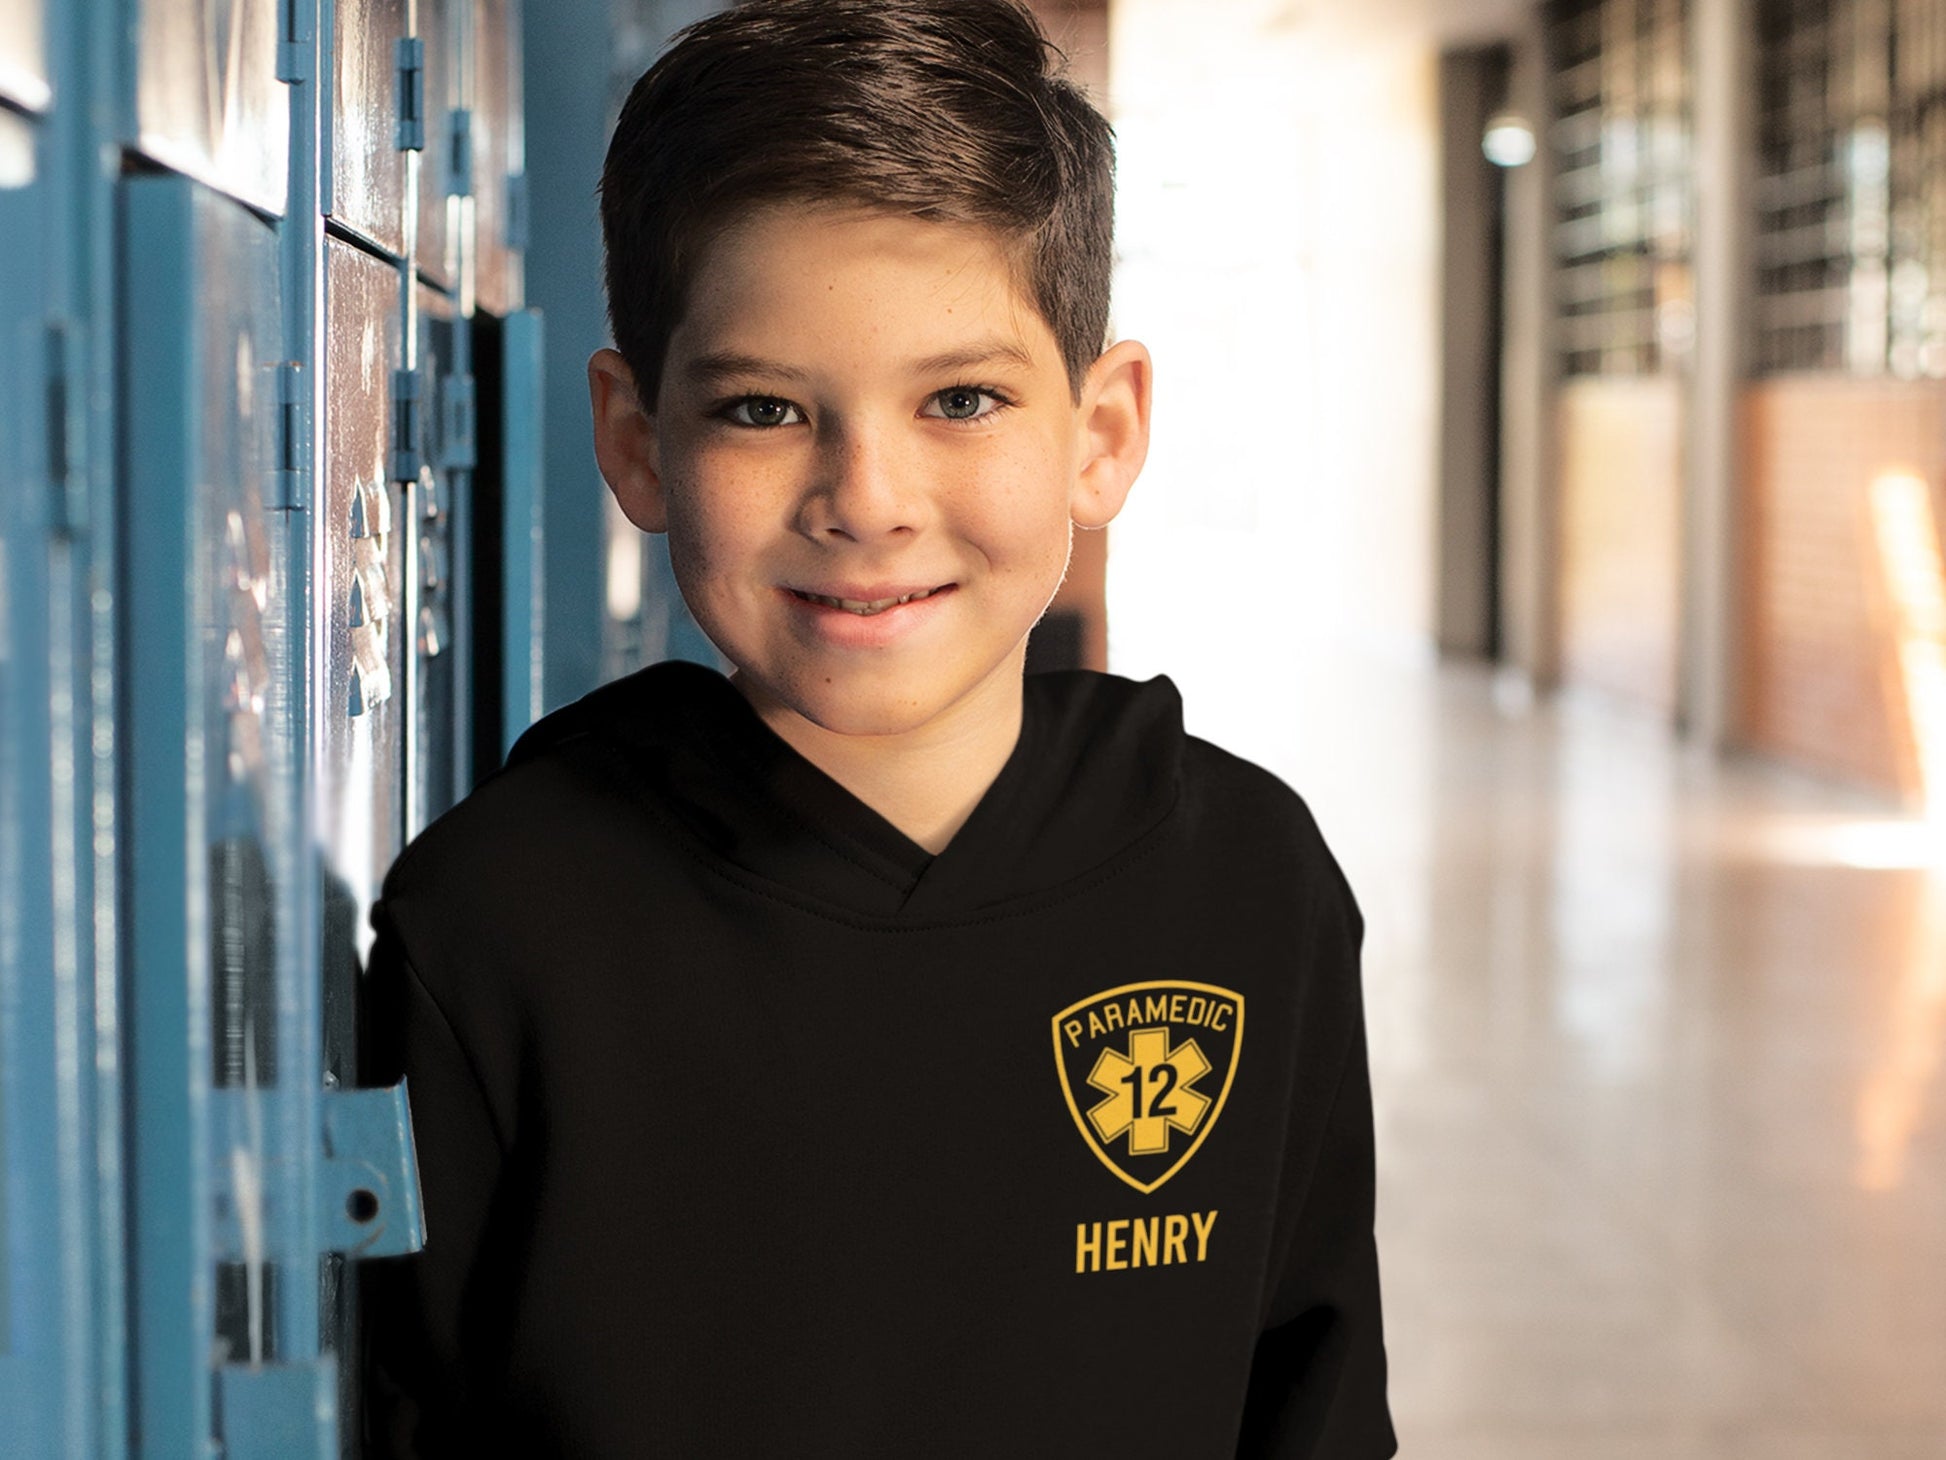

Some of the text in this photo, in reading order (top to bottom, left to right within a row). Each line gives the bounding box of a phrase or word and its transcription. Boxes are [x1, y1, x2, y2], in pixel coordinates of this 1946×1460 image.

[1064, 994, 1234, 1048] PARAMEDIC
[1121, 1062, 1178, 1119] 12
[1075, 1210, 1218, 1274] HENRY
